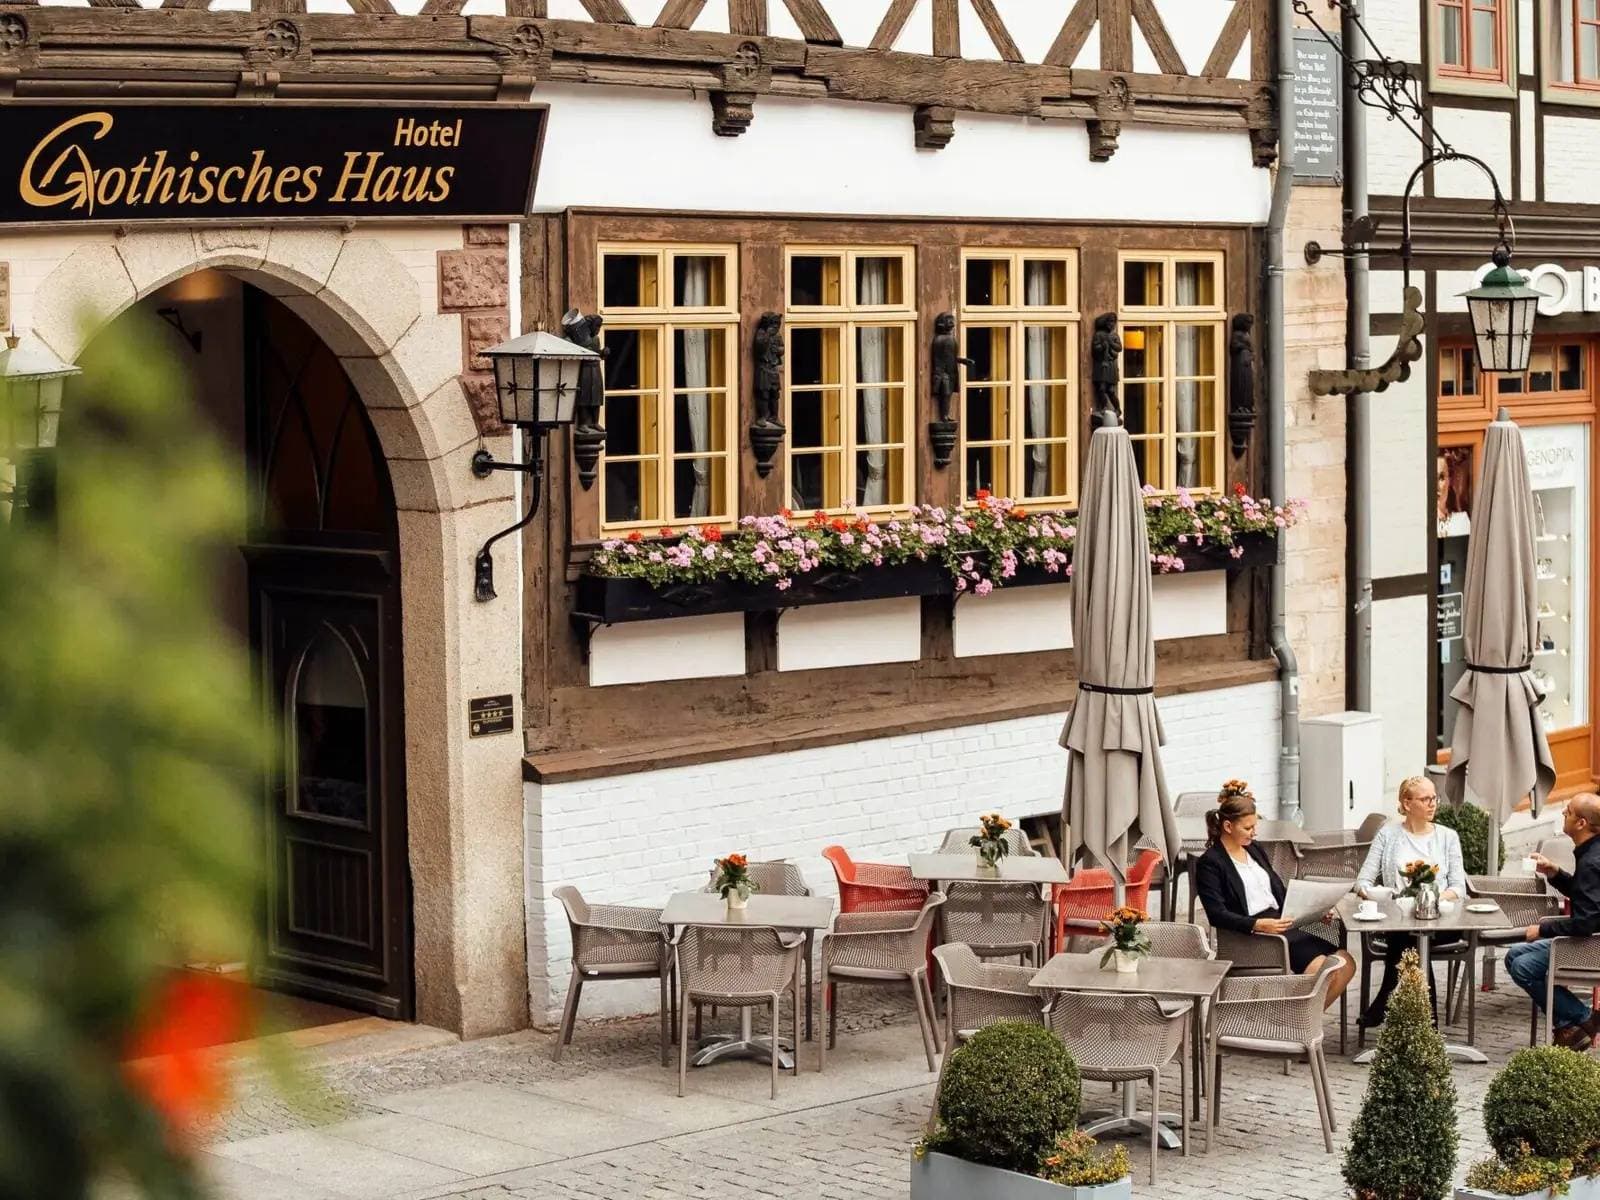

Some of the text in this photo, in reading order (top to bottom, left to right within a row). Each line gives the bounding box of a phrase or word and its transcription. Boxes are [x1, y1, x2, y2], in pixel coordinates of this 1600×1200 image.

[20, 112, 454, 216] Gothisches Haus
[395, 118, 462, 148] Hotel
